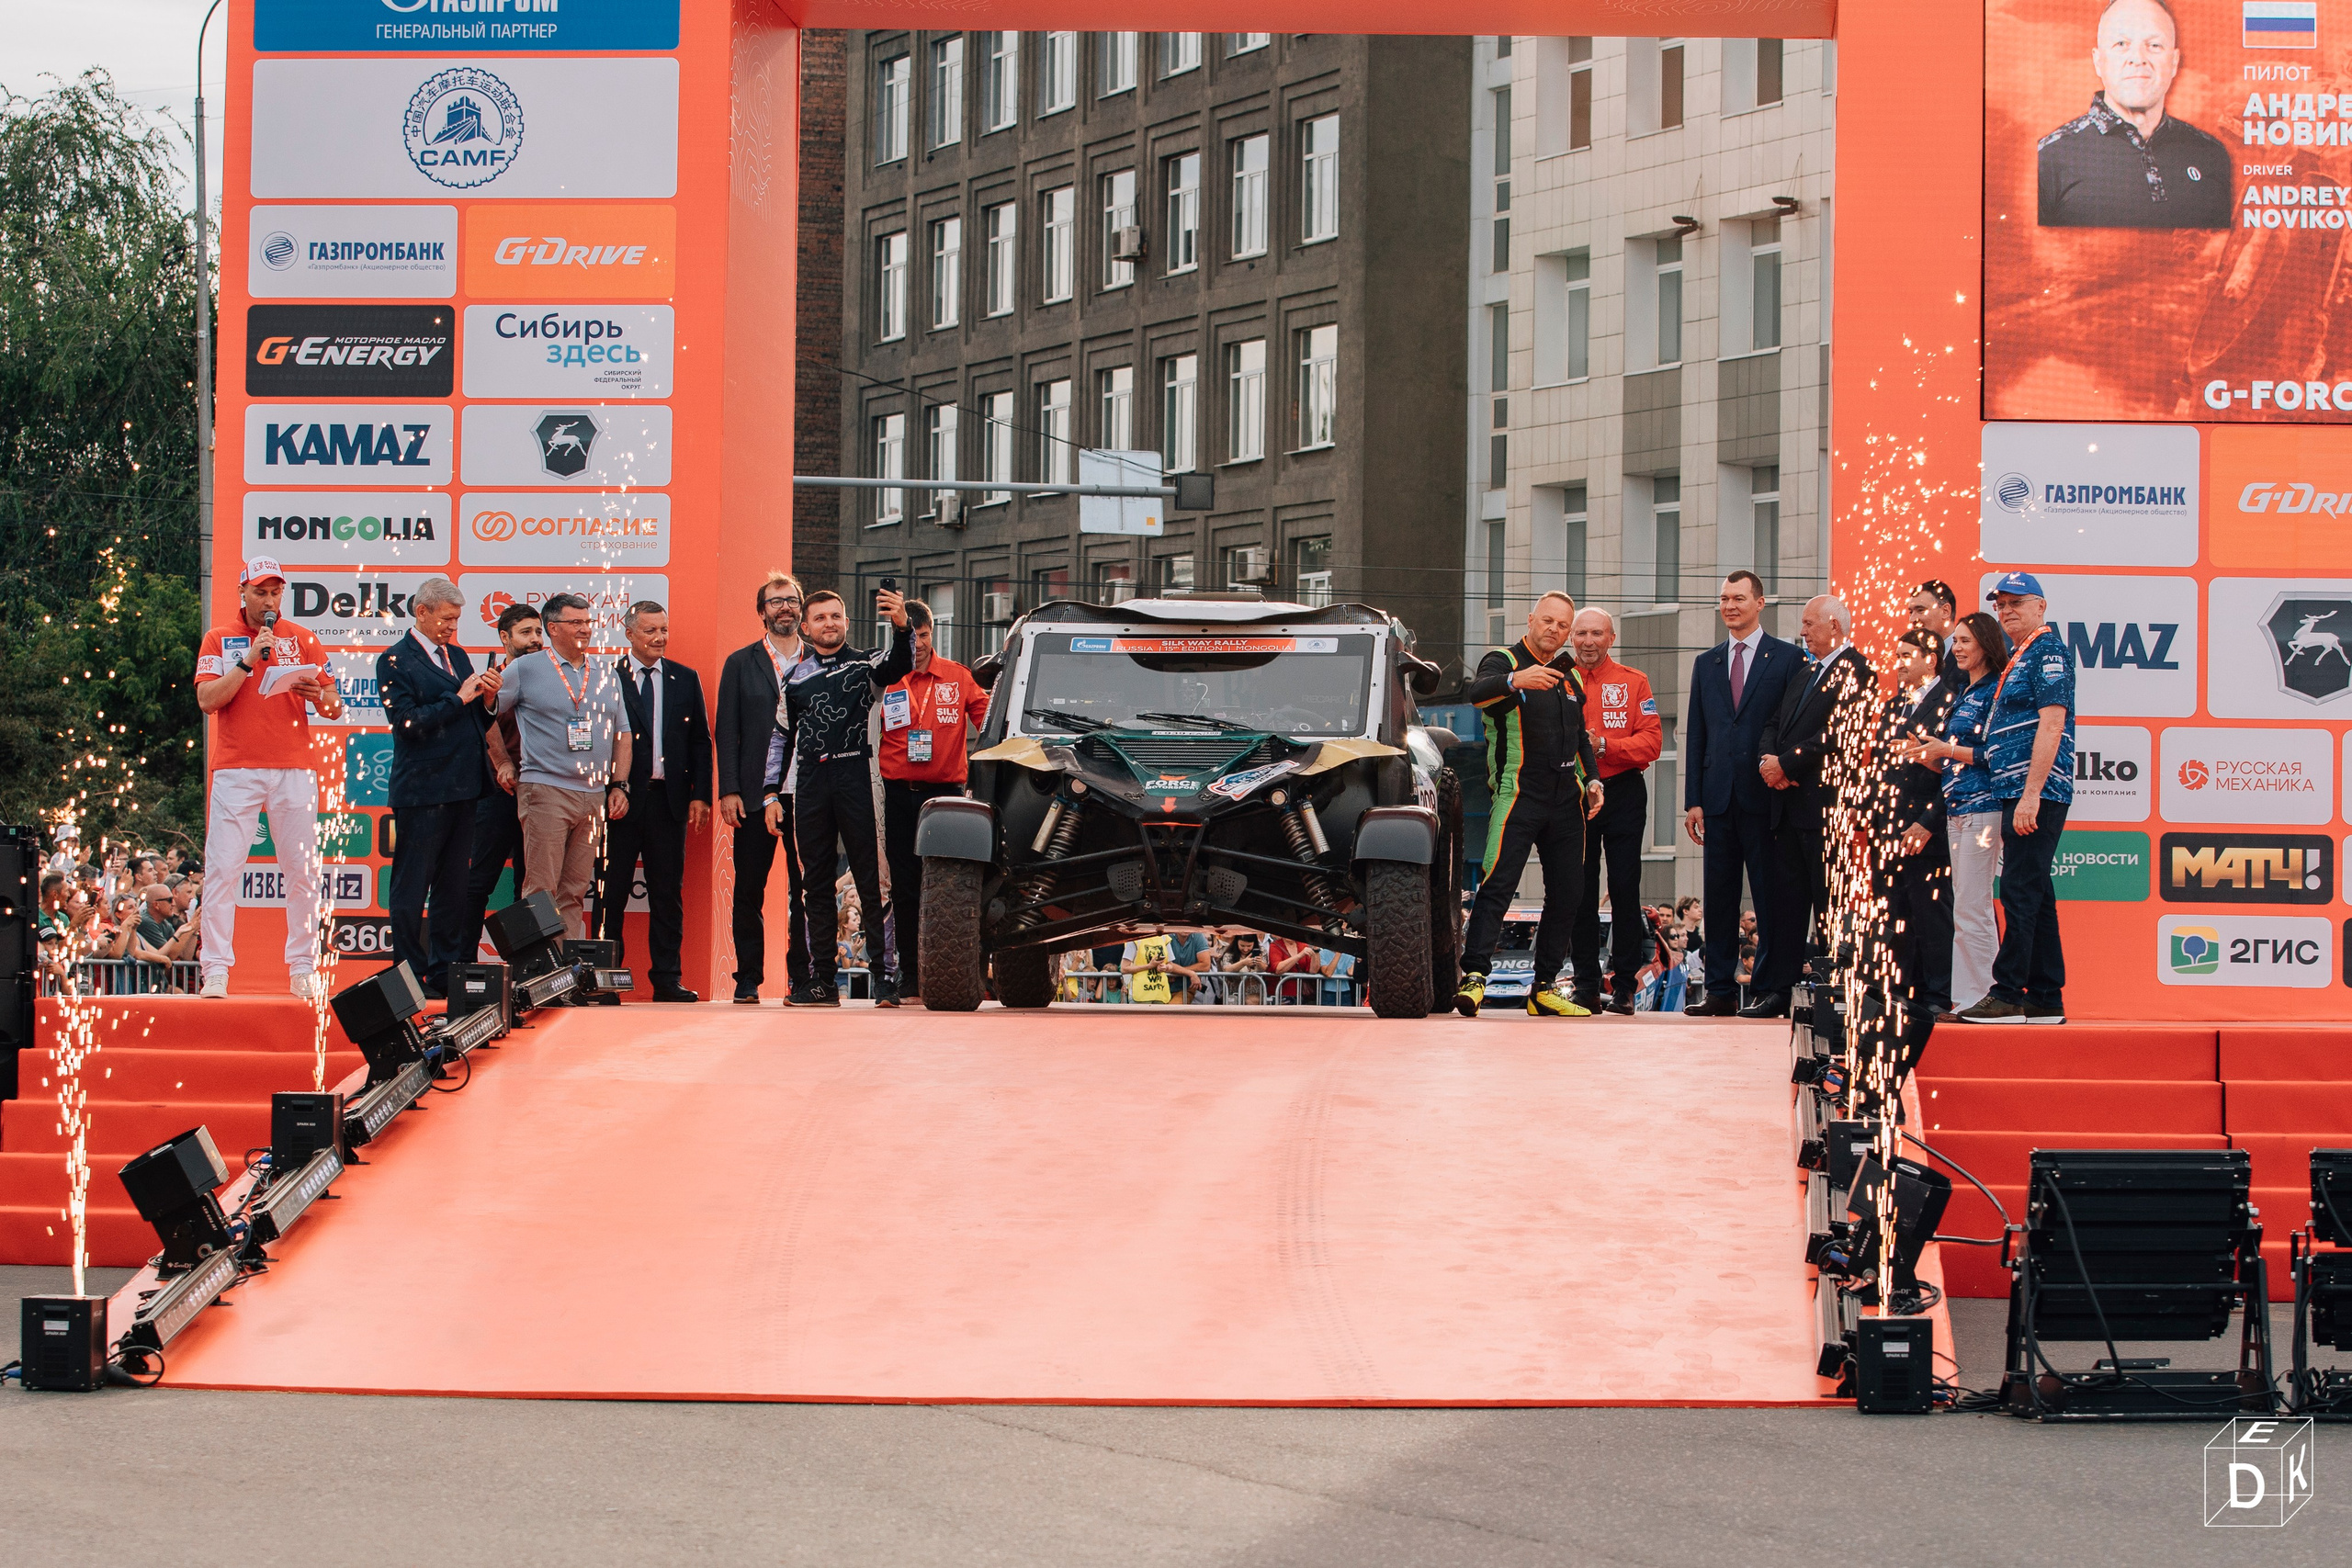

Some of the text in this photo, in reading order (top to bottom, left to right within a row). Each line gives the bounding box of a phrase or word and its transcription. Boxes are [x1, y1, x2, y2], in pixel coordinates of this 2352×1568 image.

[376, 21, 558, 39] ГЕНЕРАЛЬНЫЙ ПАРТНЕР
[2244, 66, 2312, 81] ПИЛОТ
[411, 75, 516, 139] 中国汽车摩托车运动联合会
[420, 150, 505, 166] CAMF
[2243, 165, 2292, 175] DRIVER
[2243, 186, 2351, 206] ANDREY
[309, 242, 445, 260] ГАЗПРОМБАНК
[495, 312, 623, 345] Сибирь
[546, 344, 641, 367] здесь
[266, 423, 431, 466] KAMAZ
[2045, 484, 2186, 505] ГАЗПРОМБАНК
[2237, 482, 2352, 519] G-DRI
[258, 515, 435, 541] MONGOLIA
[521, 517, 658, 536] СОГЛАСИЕ
[526, 592, 630, 609] РУКАЯ
[2046, 621, 2179, 670] MAZ
[277, 657, 300, 665] SILK
[335, 679, 379, 695] АЗПРО
[936, 707, 959, 716] SILK
[936, 716, 959, 724] WAY
[1602, 711, 1627, 720] SILK
[1602, 720, 1627, 728] WAY
[2075, 751, 2138, 782] lko
[2216, 761, 2302, 775] РУССКАЯ
[2216, 777, 2315, 792] МЕХАНИКА
[2062, 852, 2139, 865] НОВОСТИ
[2049, 865, 2078, 876] ОРТ
[2172, 847, 2321, 890] МАТЧ!
[243, 873, 331, 898] ИЗВЕЯ
[338, 924, 394, 952] 360
[2229, 938, 2320, 965] 2ГИС
[1491, 960, 1574, 971] ONGA
